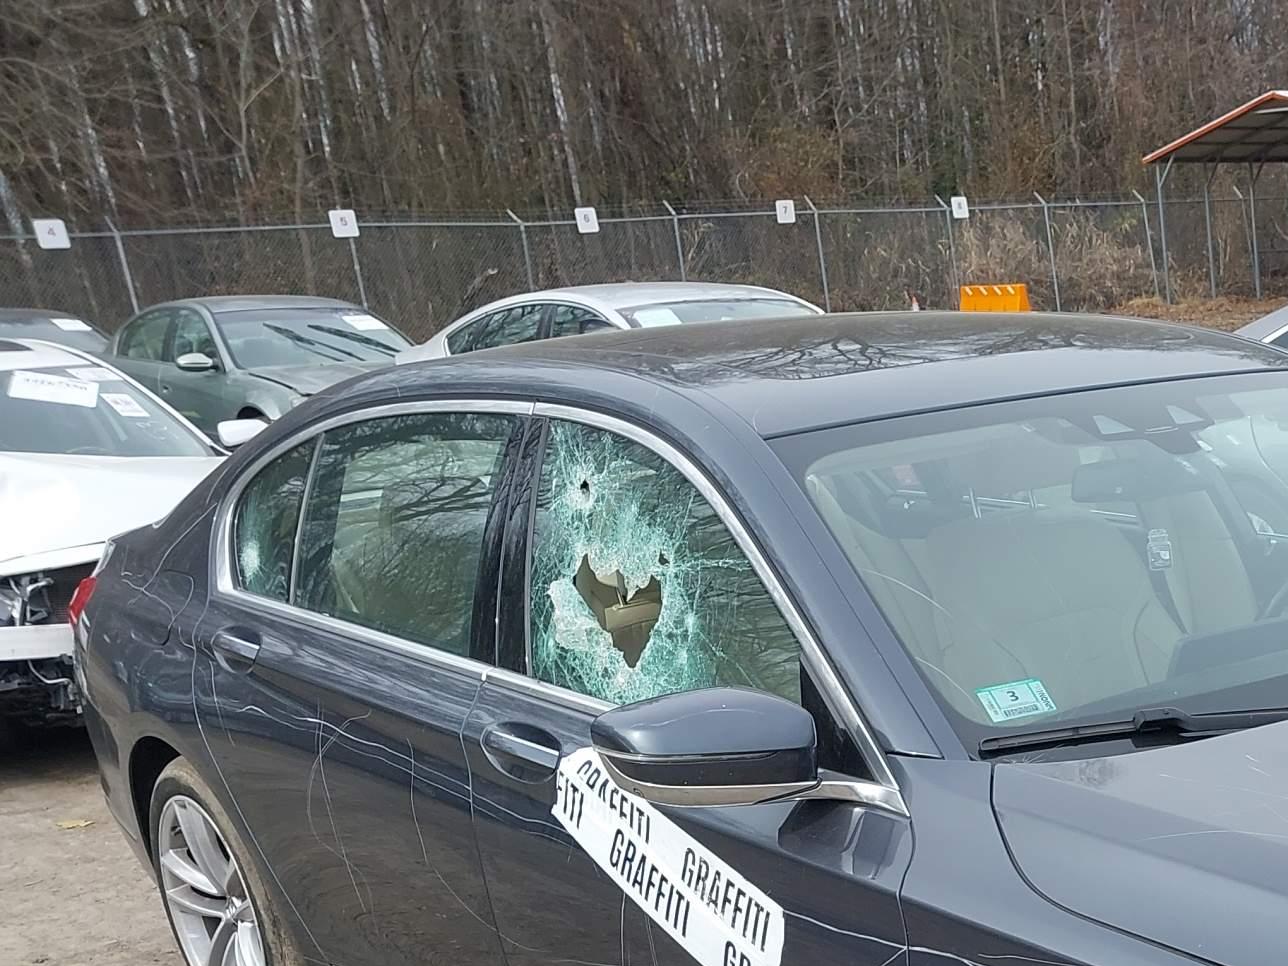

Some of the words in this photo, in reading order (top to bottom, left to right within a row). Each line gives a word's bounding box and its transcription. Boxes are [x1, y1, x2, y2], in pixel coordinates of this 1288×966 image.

[782, 206, 788, 215] 7
[339, 216, 348, 226] 5
[583, 214, 590, 223] 6
[47, 226, 57, 237] 4
[1006, 690, 1020, 702] 3
[609, 828, 691, 938] GRAFFITI
[681, 847, 770, 953] GRAFFITI
